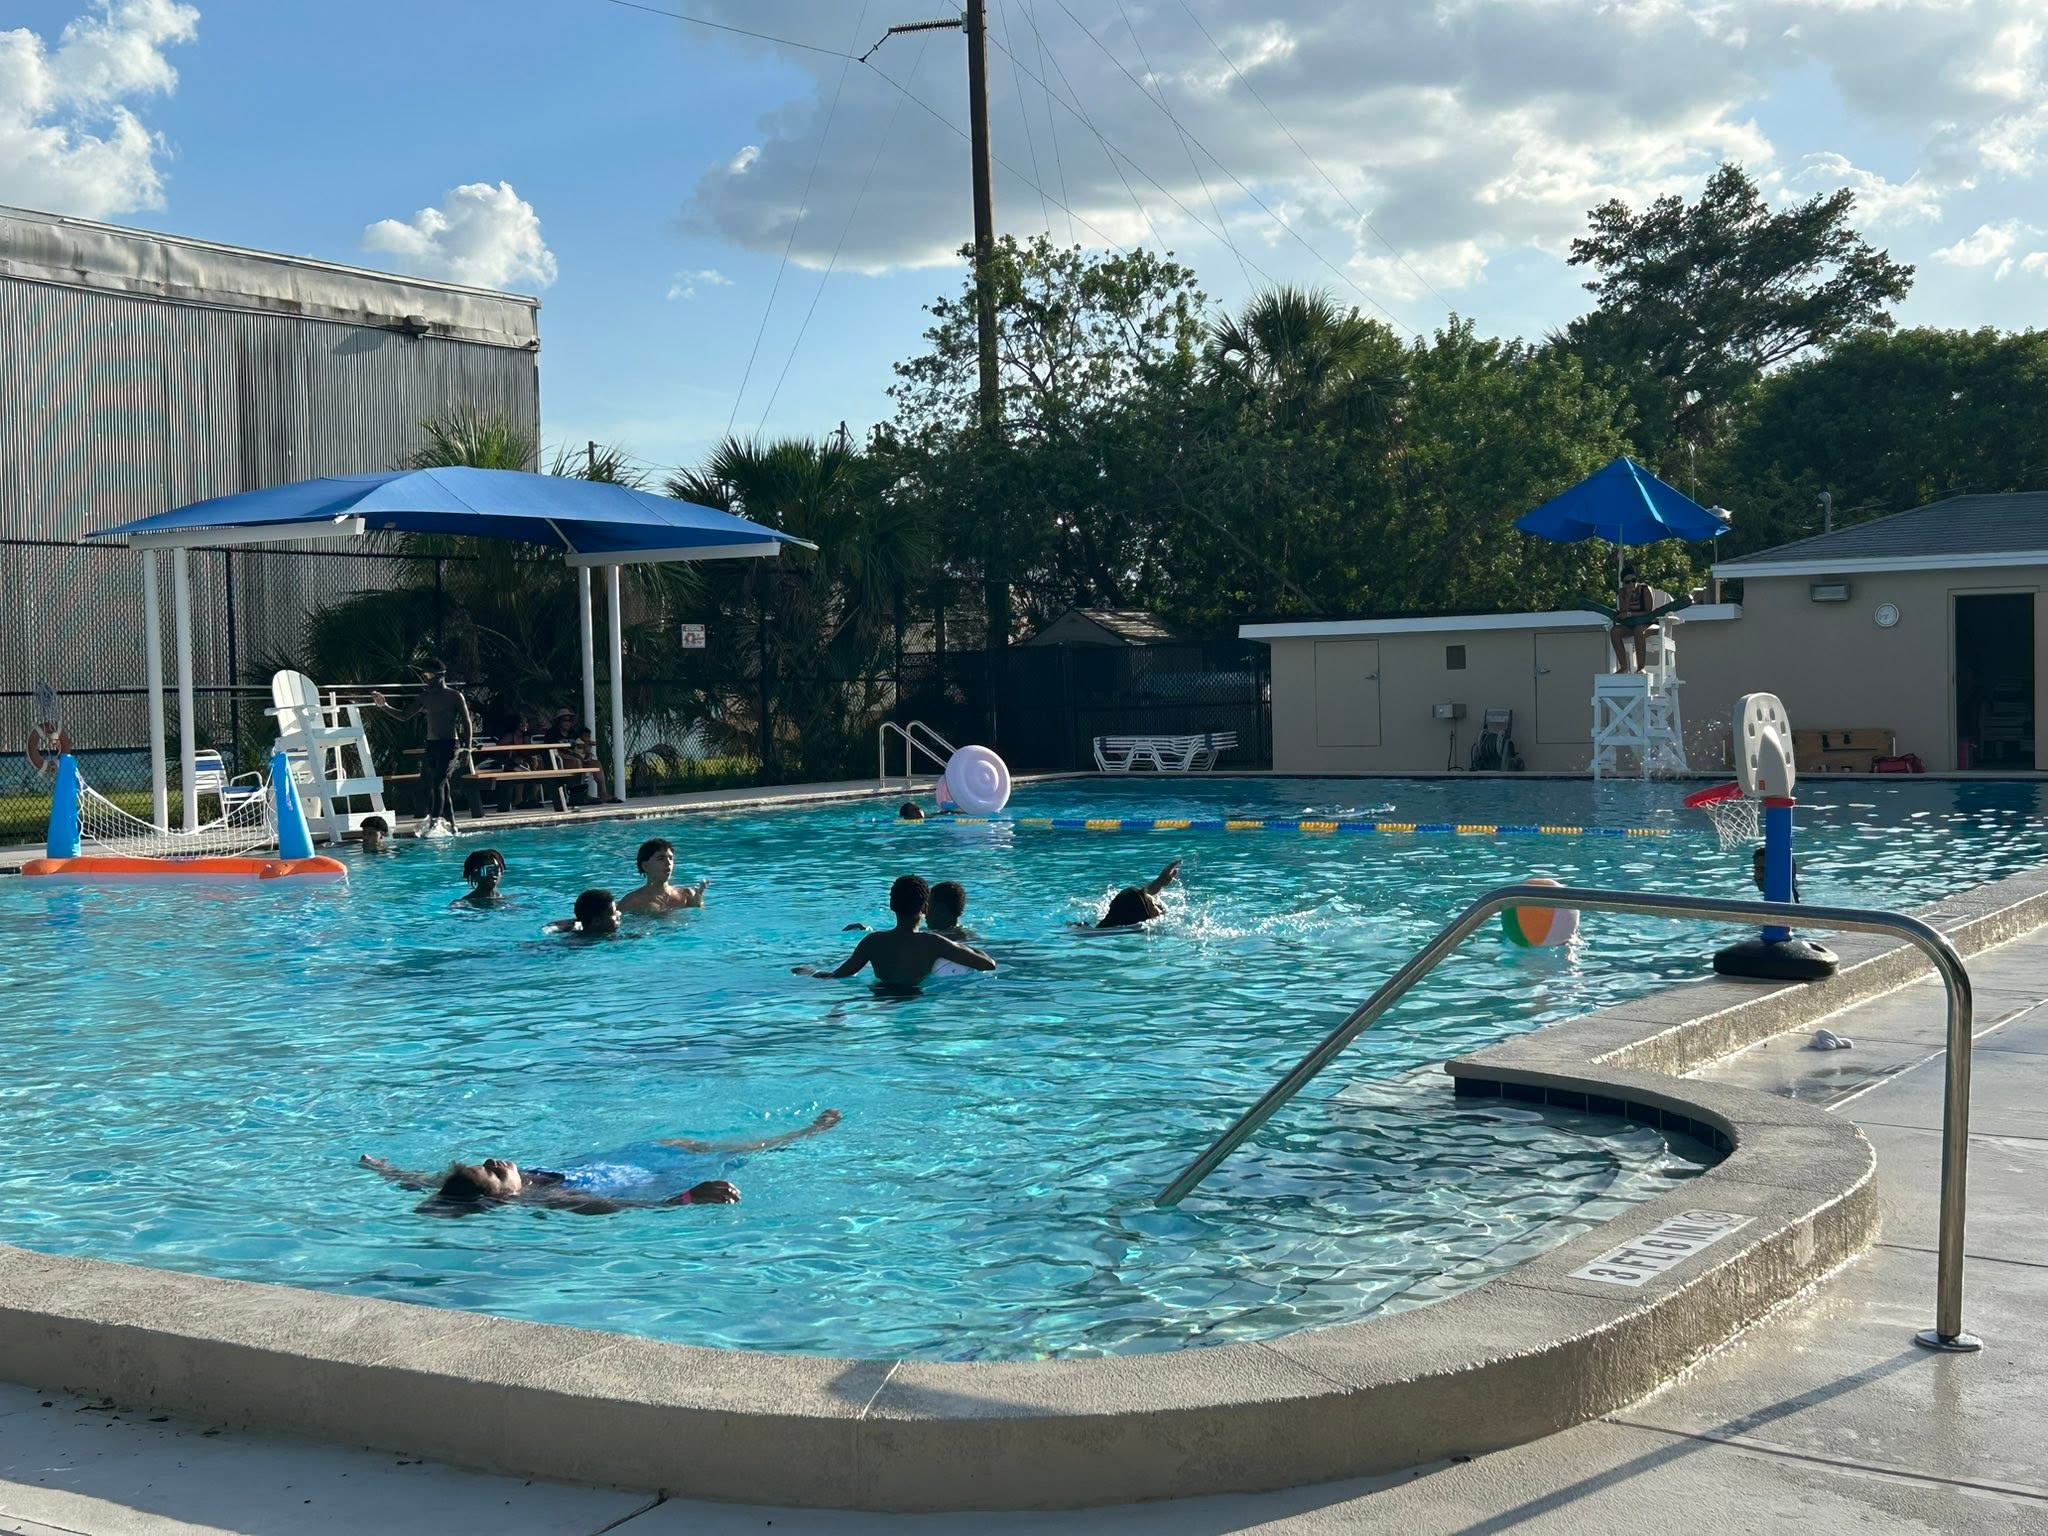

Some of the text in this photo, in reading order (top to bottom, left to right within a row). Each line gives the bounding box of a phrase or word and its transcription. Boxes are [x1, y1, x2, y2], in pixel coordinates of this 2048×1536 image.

[1641, 1239, 1692, 1251] 6
[1606, 1250, 1676, 1269] FT
[1589, 1267, 1641, 1280] 3
